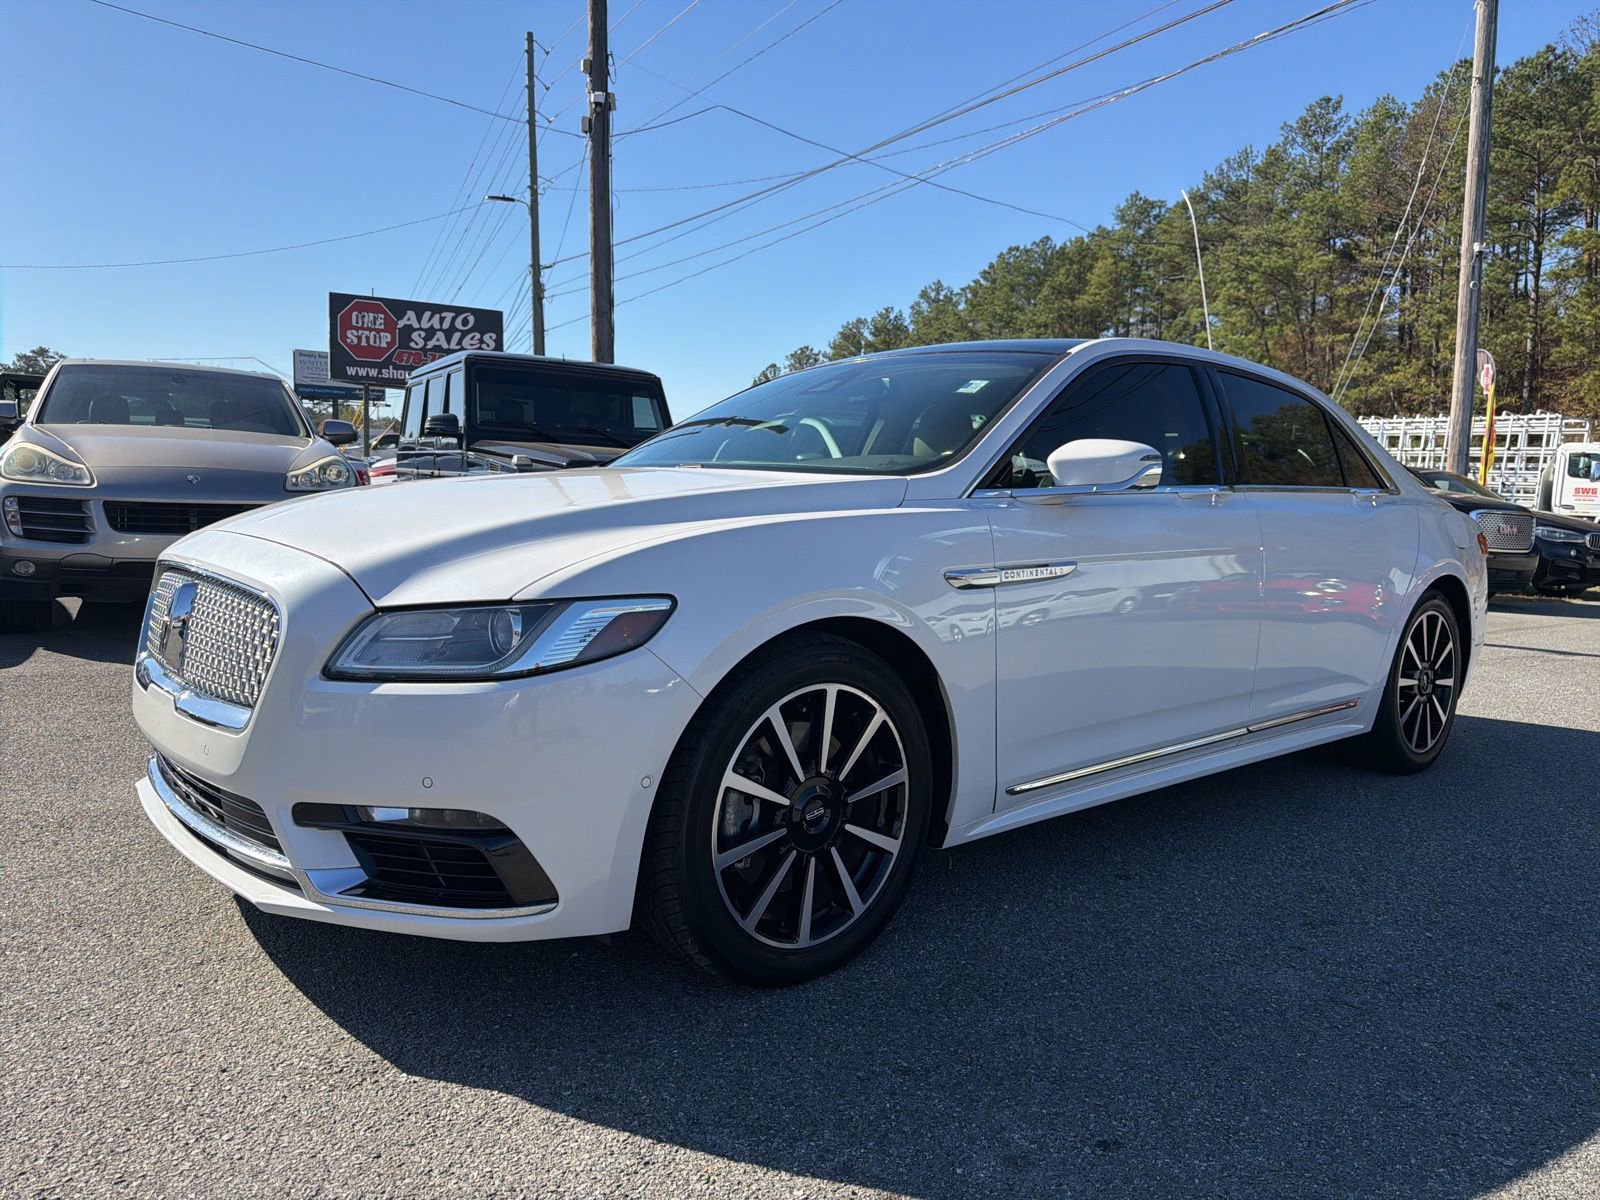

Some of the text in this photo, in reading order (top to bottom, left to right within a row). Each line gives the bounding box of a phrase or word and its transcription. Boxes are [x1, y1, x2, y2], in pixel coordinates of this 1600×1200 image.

[351, 311, 385, 329] ONE
[397, 310, 475, 330] AUTO
[346, 330, 392, 348] STOP
[1574, 487, 1599, 495] SWG
[1004, 568, 1057, 579] CONTINENTAL
